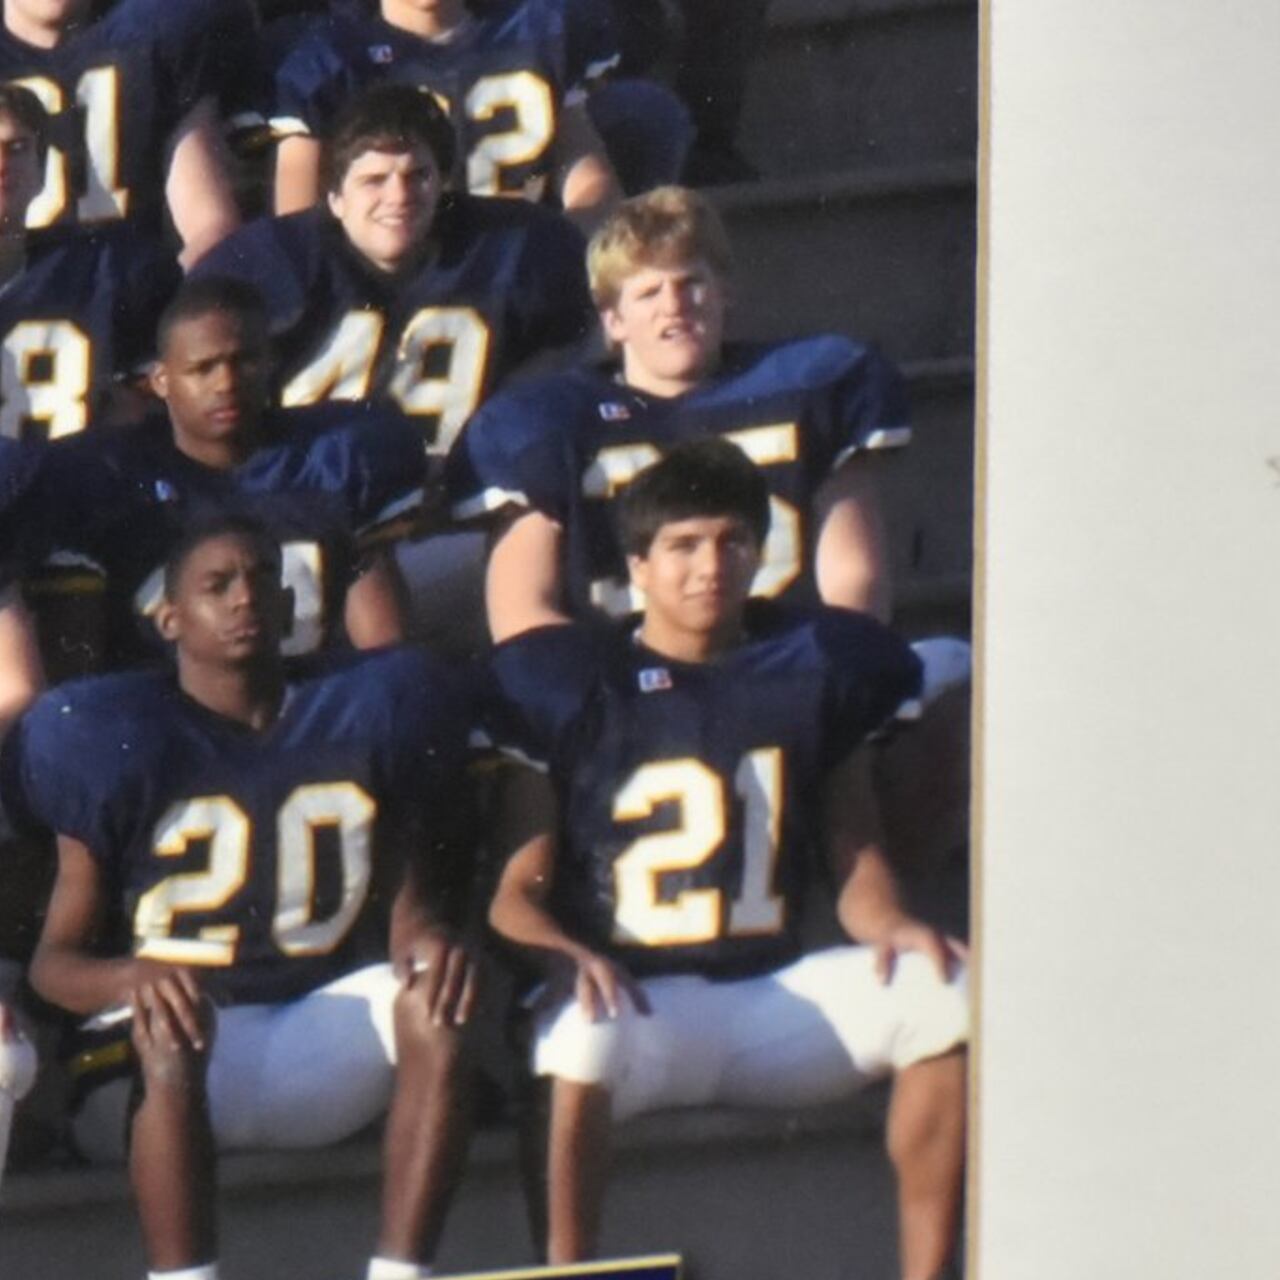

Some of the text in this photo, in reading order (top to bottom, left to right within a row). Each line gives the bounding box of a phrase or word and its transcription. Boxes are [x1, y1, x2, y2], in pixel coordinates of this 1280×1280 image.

[280, 306, 489, 457] 49
[133, 781, 376, 968] 20
[612, 747, 786, 948] 21
